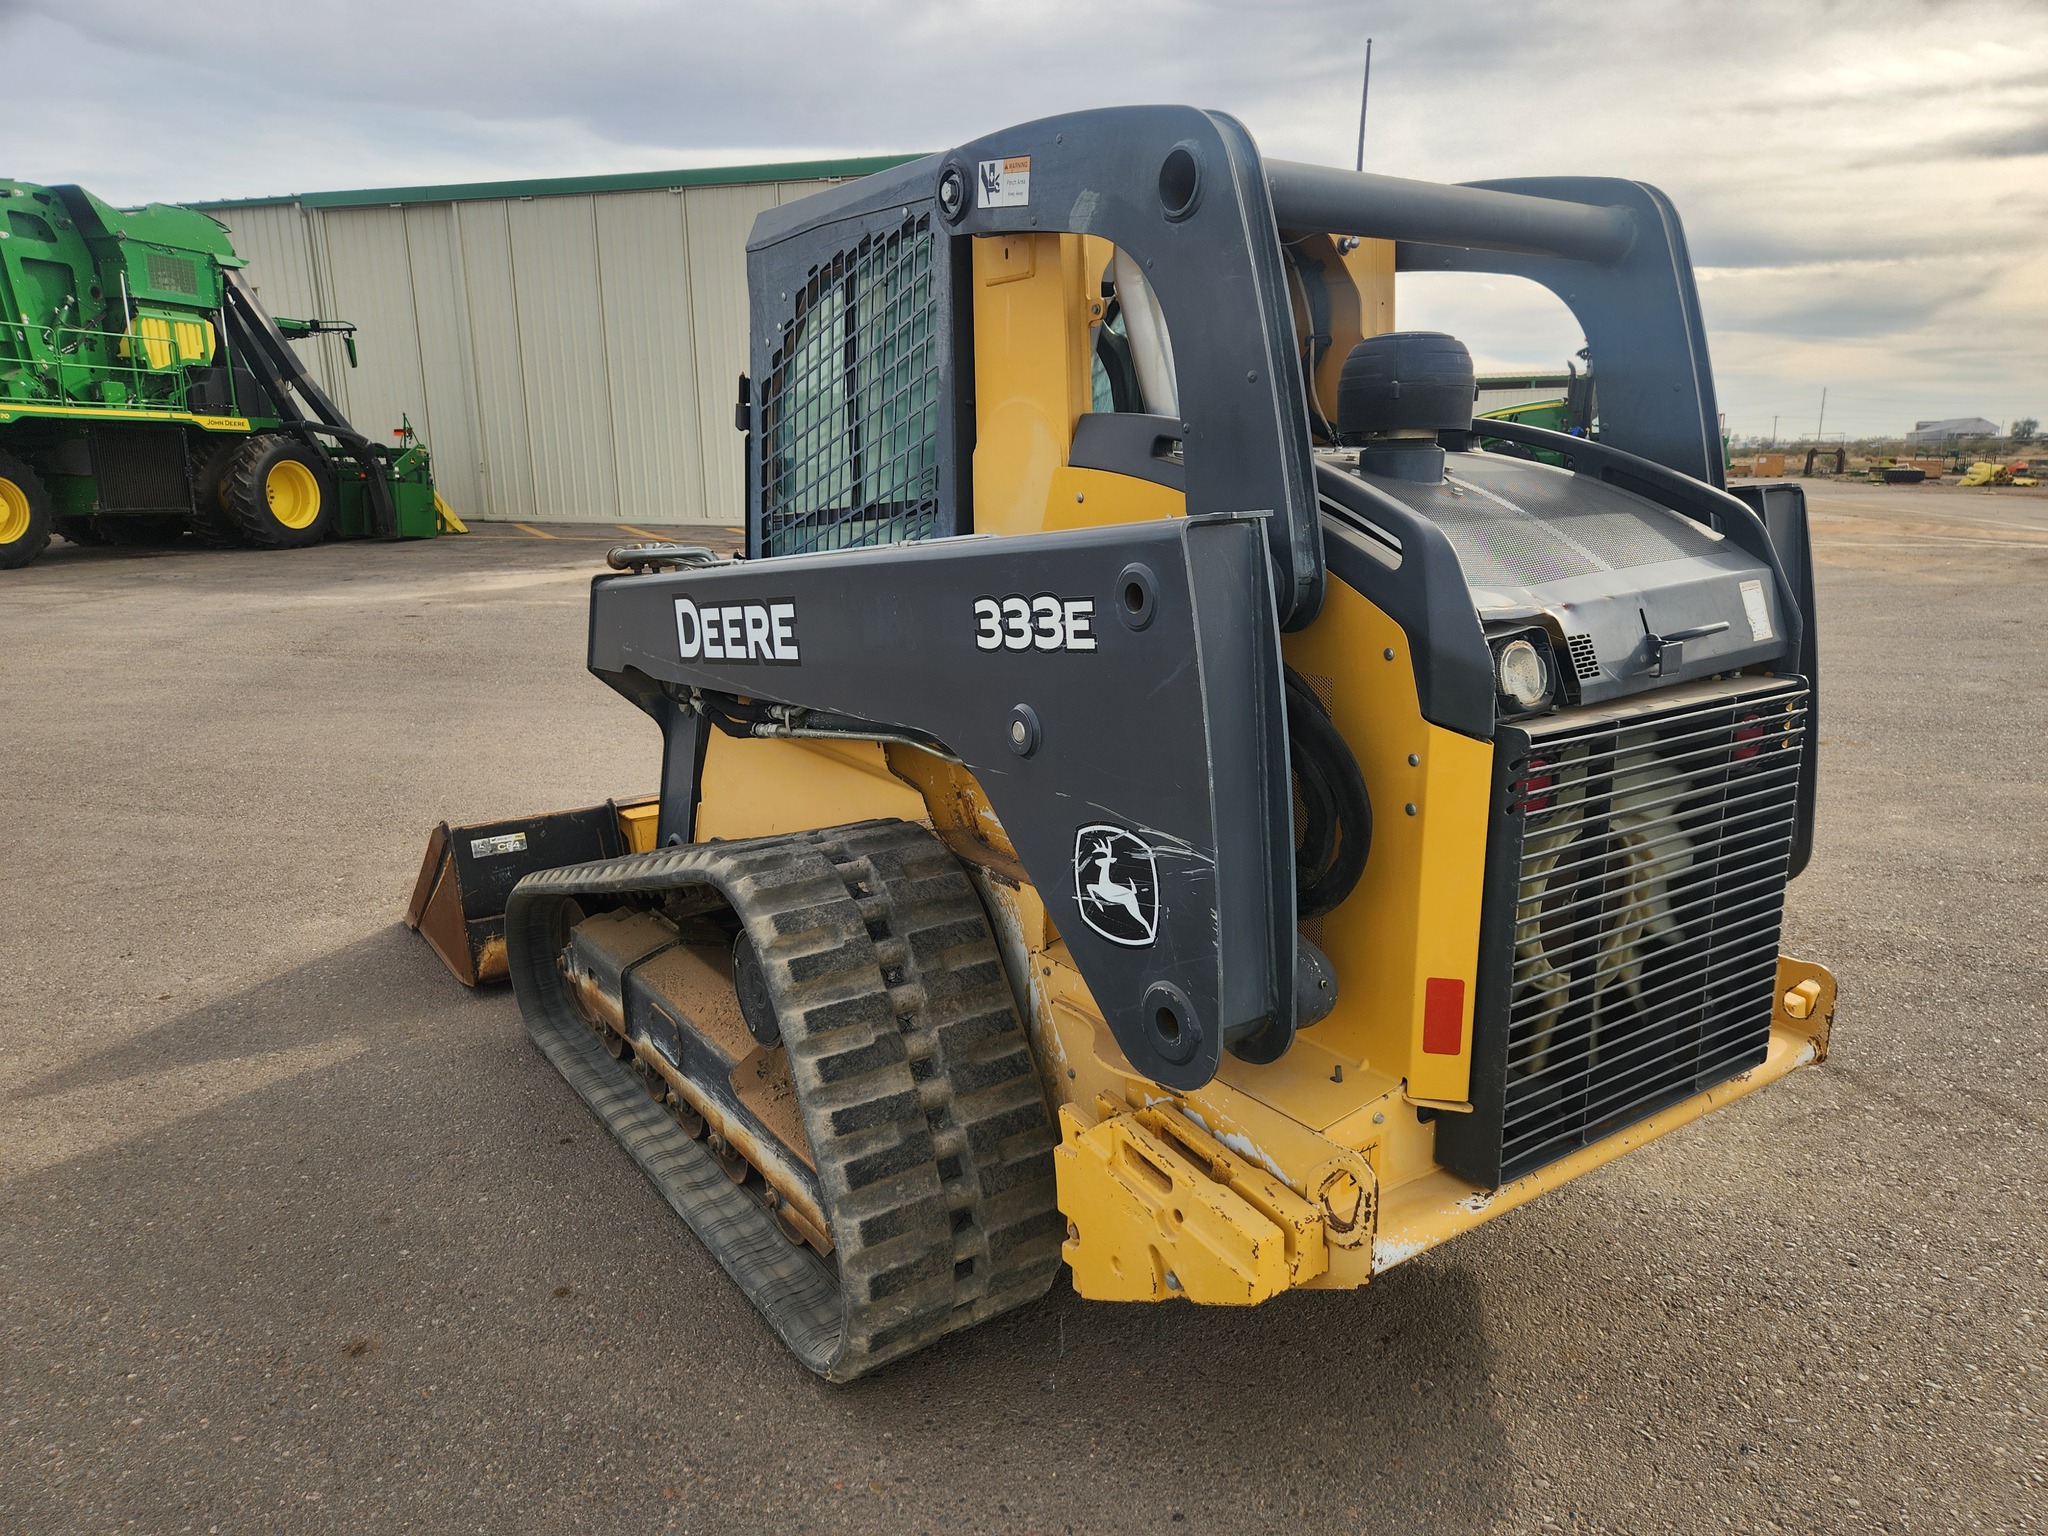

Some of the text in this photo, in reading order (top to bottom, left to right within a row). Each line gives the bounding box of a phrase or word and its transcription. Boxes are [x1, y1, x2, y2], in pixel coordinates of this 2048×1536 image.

[1009, 161, 1028, 169] WARNING
[674, 598, 799, 660] DEERE
[974, 596, 1095, 650] 333E
